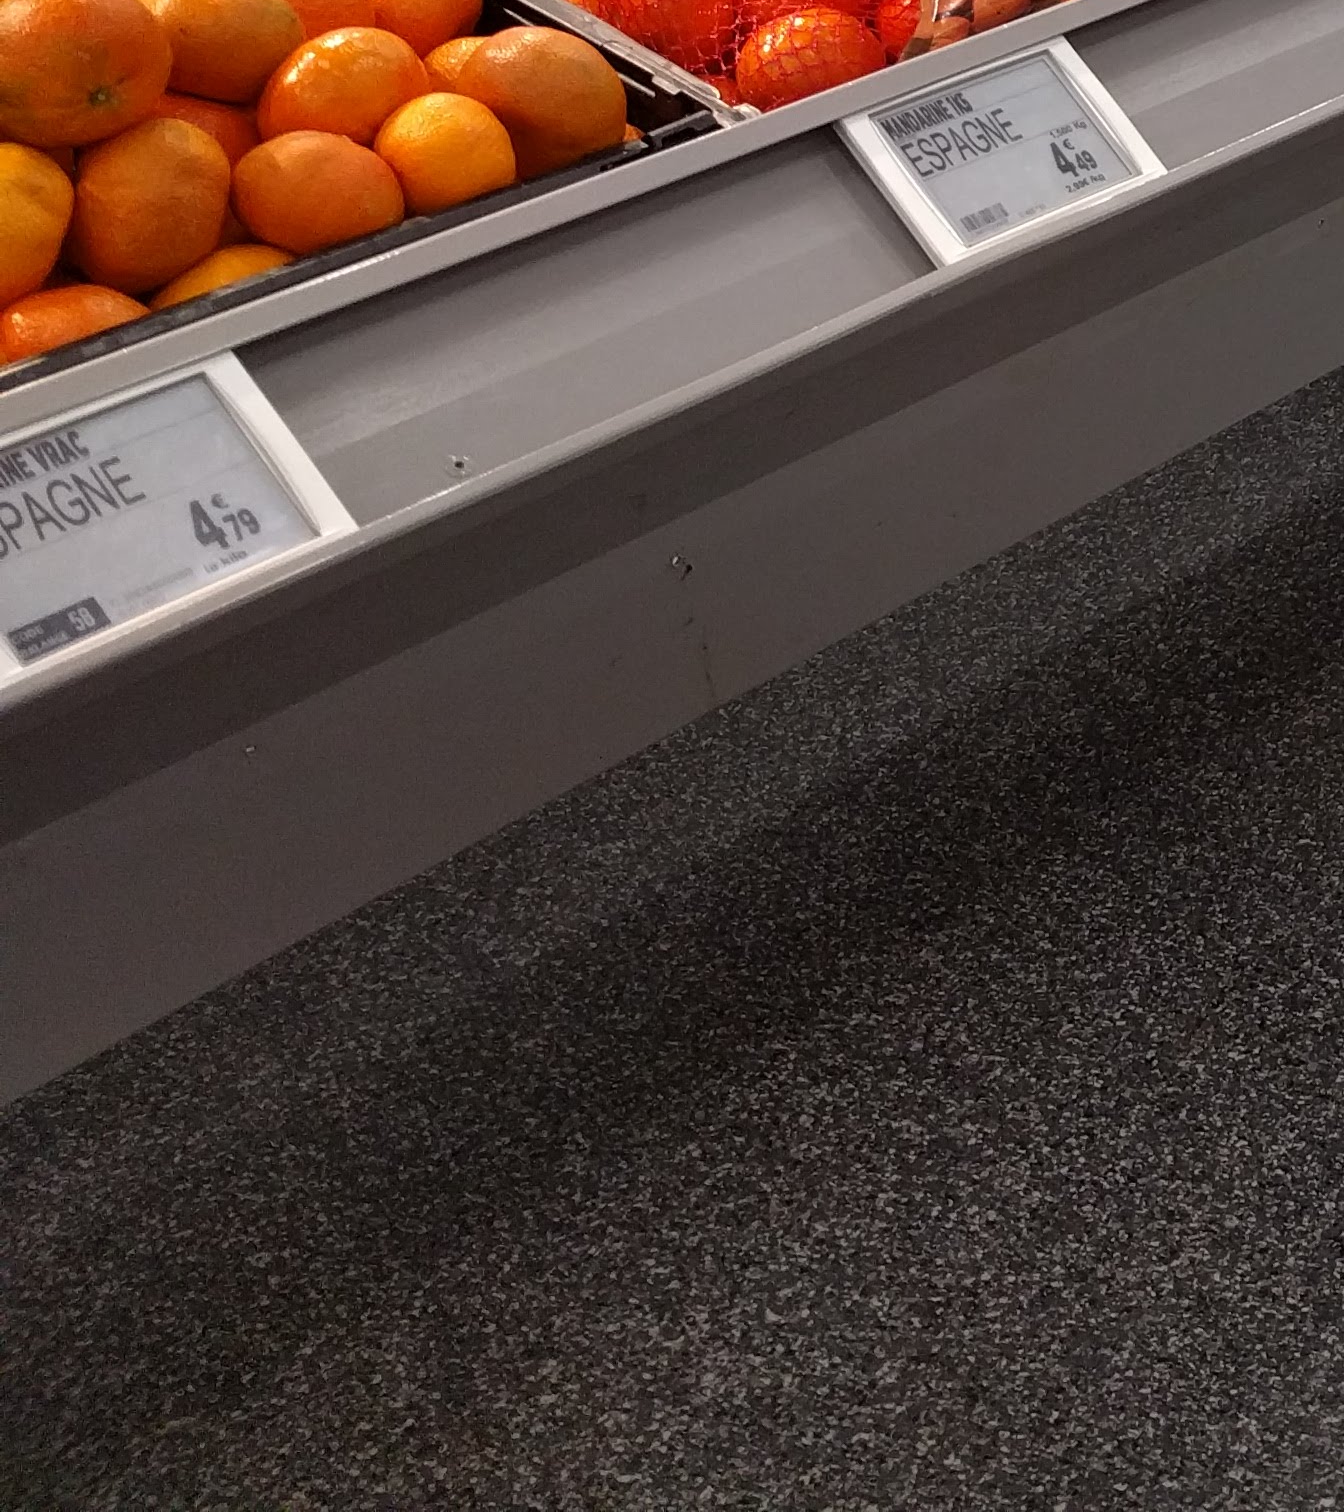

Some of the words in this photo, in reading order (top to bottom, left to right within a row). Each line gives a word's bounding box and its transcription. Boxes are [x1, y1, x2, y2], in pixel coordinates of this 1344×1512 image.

[880, 96, 953, 139] MANDARINE
[900, 108, 1024, 178] ESPAGNE
[27, 431, 91, 473] VRAC
[67, 606, 98, 632] 58
